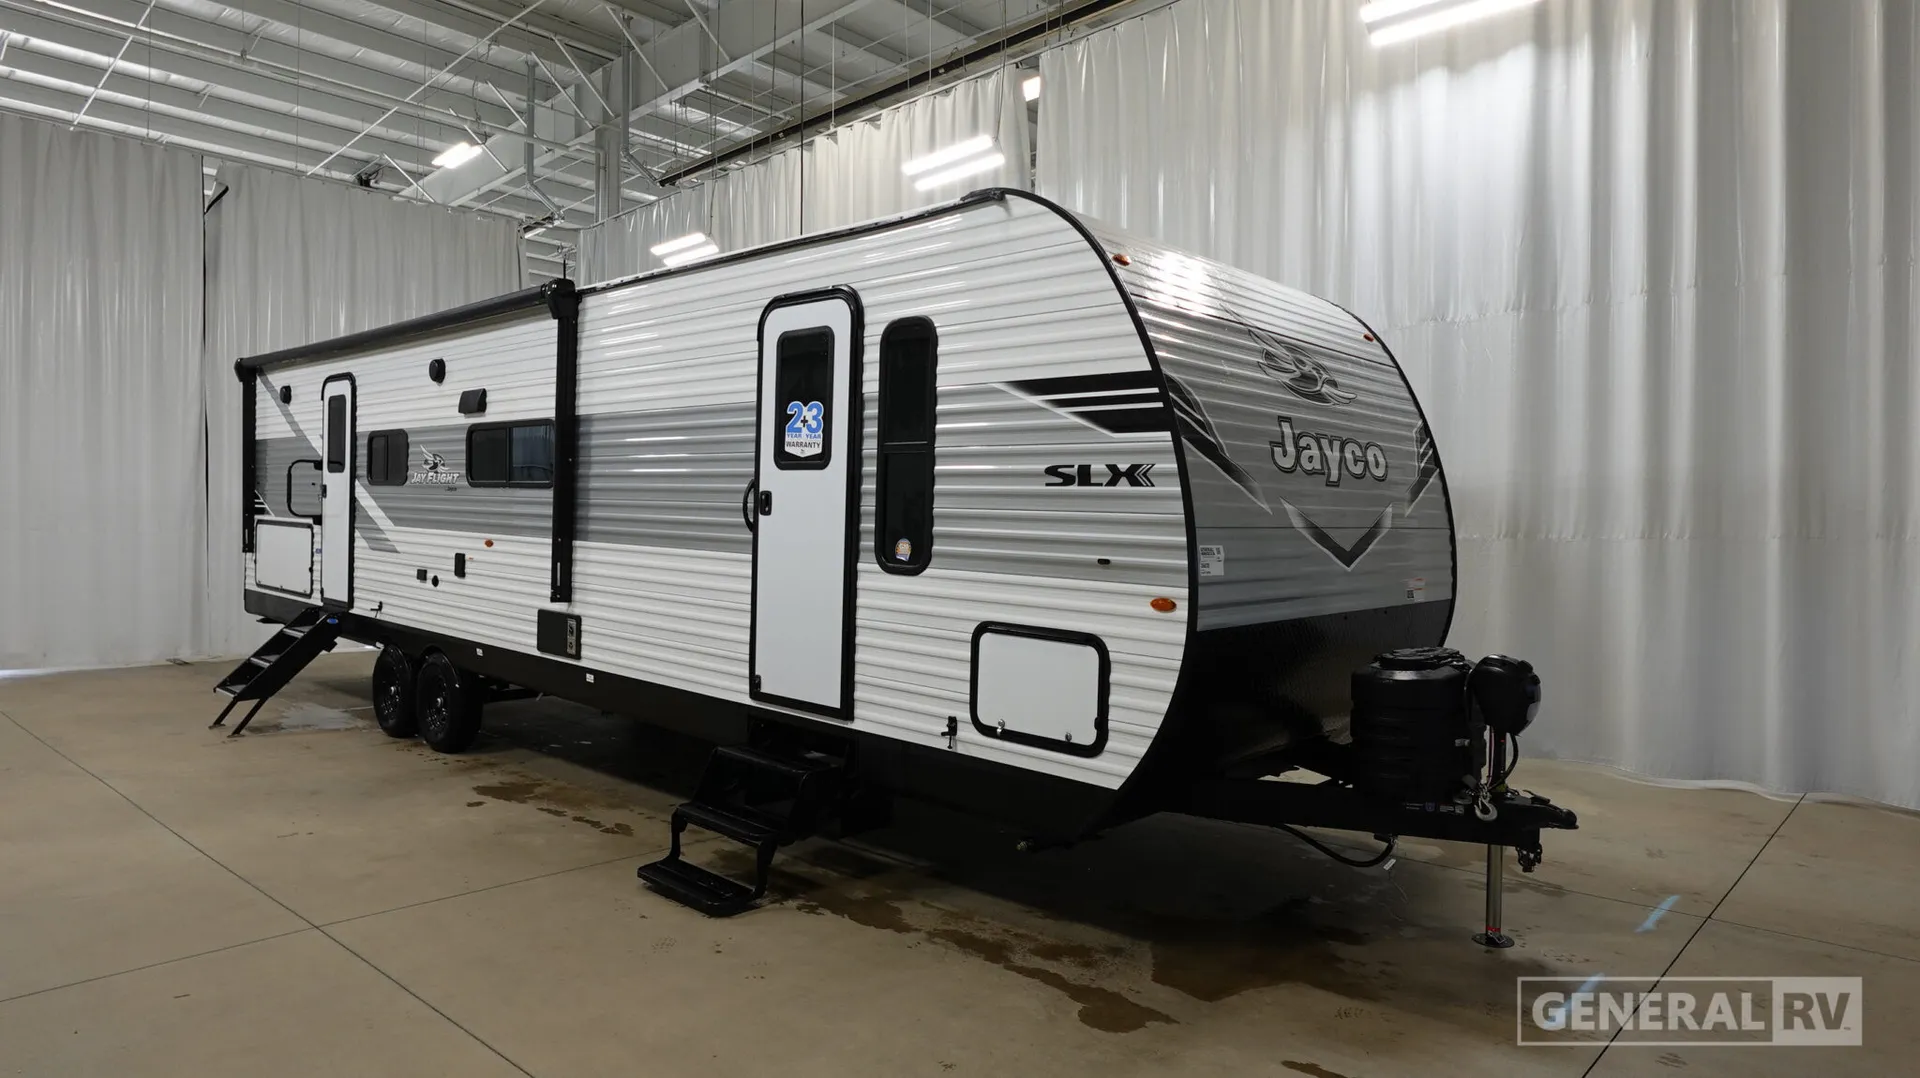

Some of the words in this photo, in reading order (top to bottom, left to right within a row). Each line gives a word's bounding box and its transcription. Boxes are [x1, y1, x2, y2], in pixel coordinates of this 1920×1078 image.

[786, 440, 821, 449] WARRANTY
[1269, 415, 1388, 487] Jayco
[410, 472, 427, 484] JAY
[427, 471, 460, 485] FLIGHT
[1044, 464, 1156, 488] SLX
